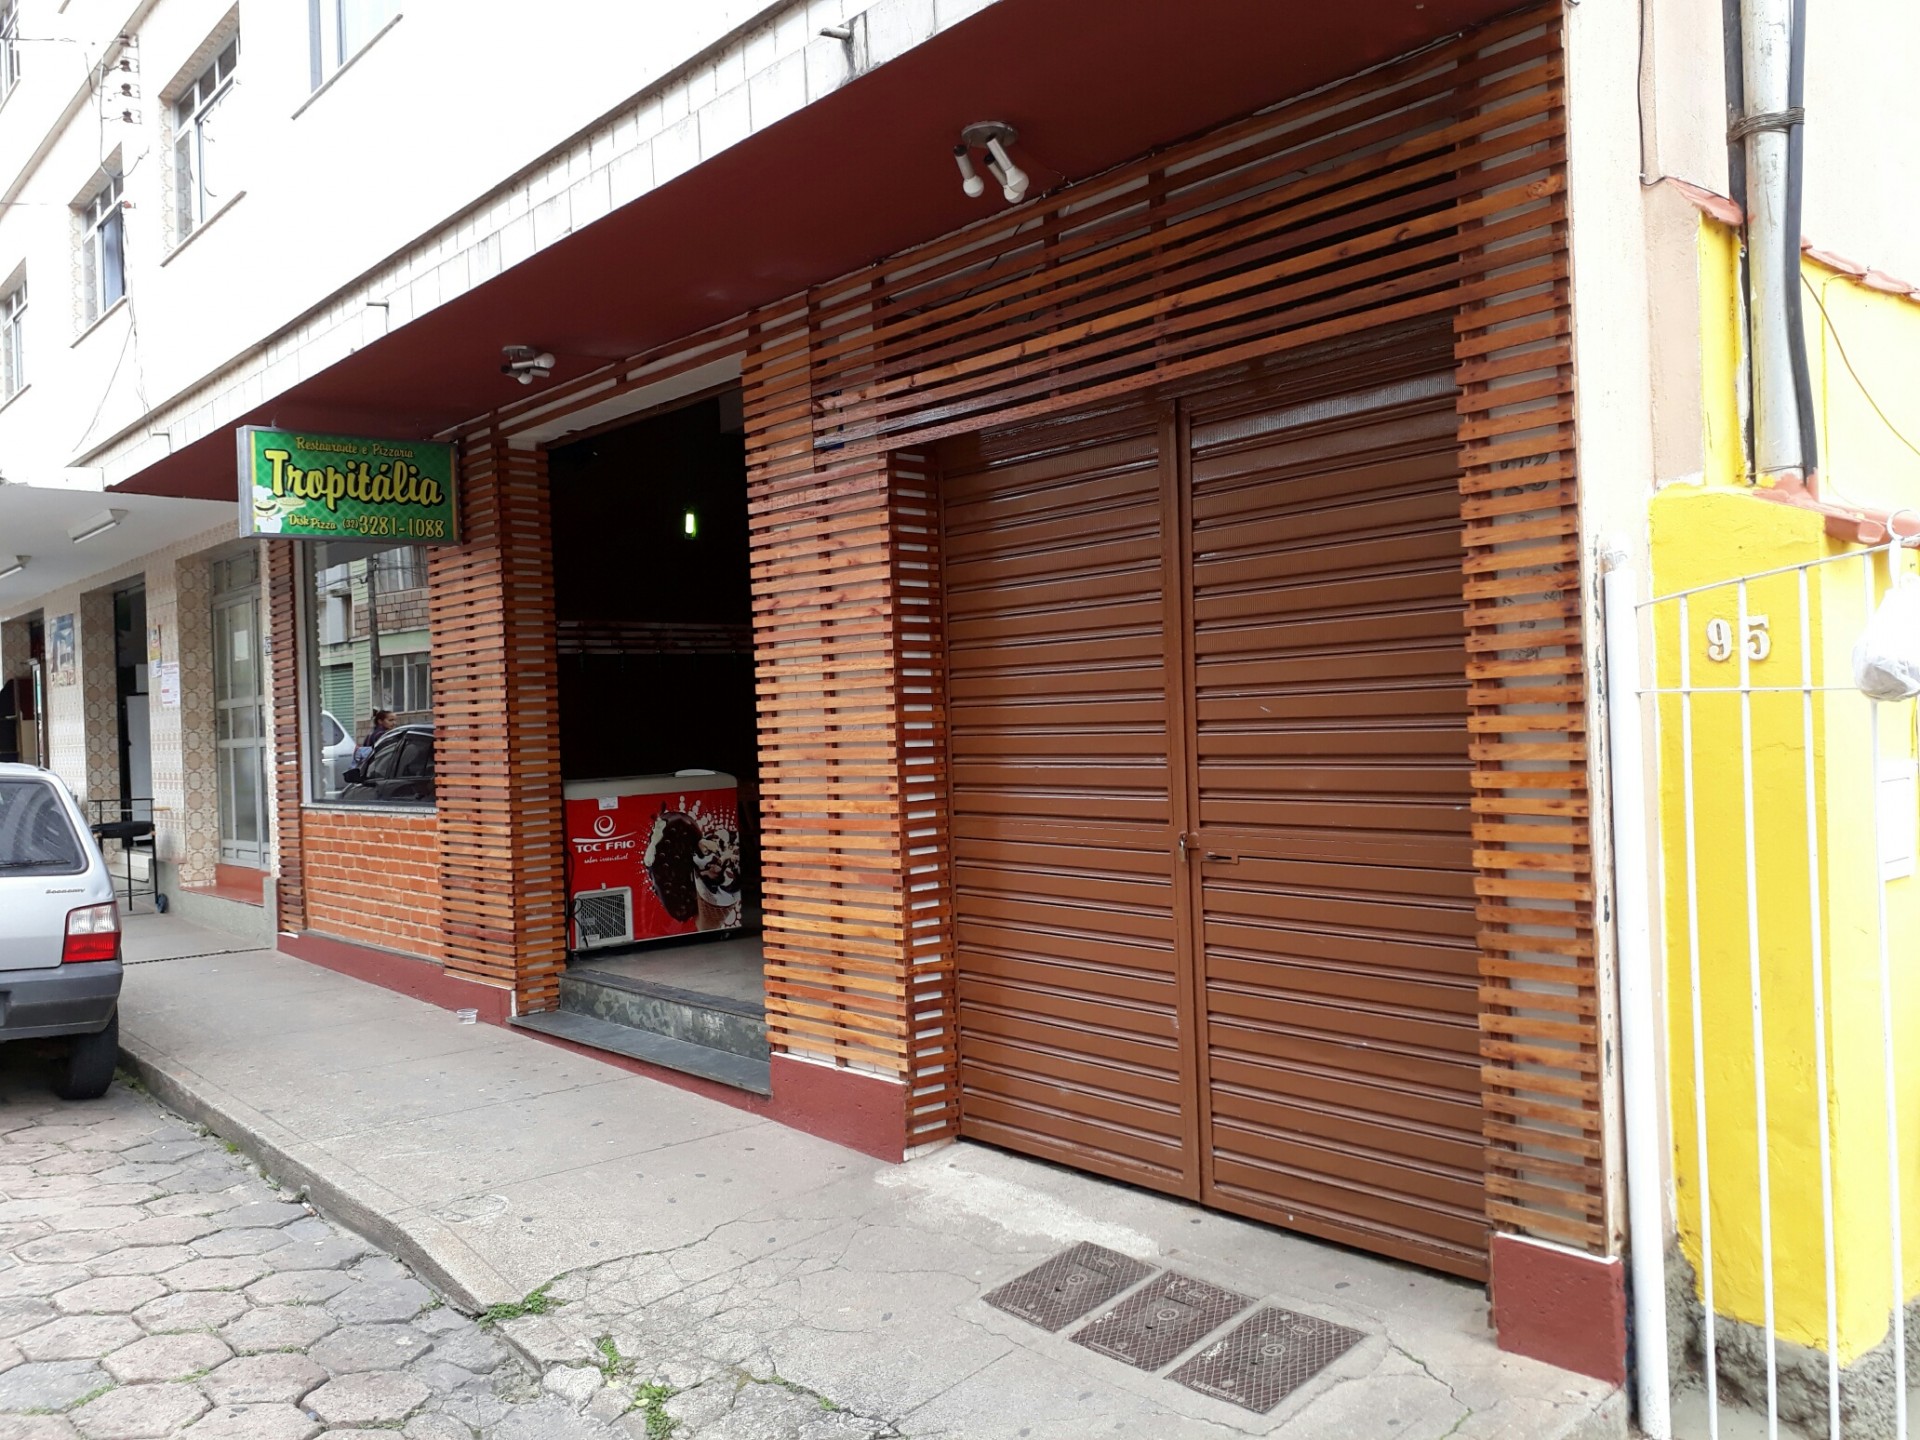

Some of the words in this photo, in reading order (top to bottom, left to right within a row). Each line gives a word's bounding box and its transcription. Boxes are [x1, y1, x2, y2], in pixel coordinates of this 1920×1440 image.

[296, 437, 357, 453] Restaurante
[362, 446, 368, 455] e
[372, 443, 413, 458] Pizzaria
[264, 449, 443, 511] Tropitália
[289, 514, 309, 526] Disk
[310, 517, 337, 529] Pizza
[1706, 614, 1771, 662] 95
[575, 843, 602, 854] TOC
[605, 840, 635, 850] FRIO
